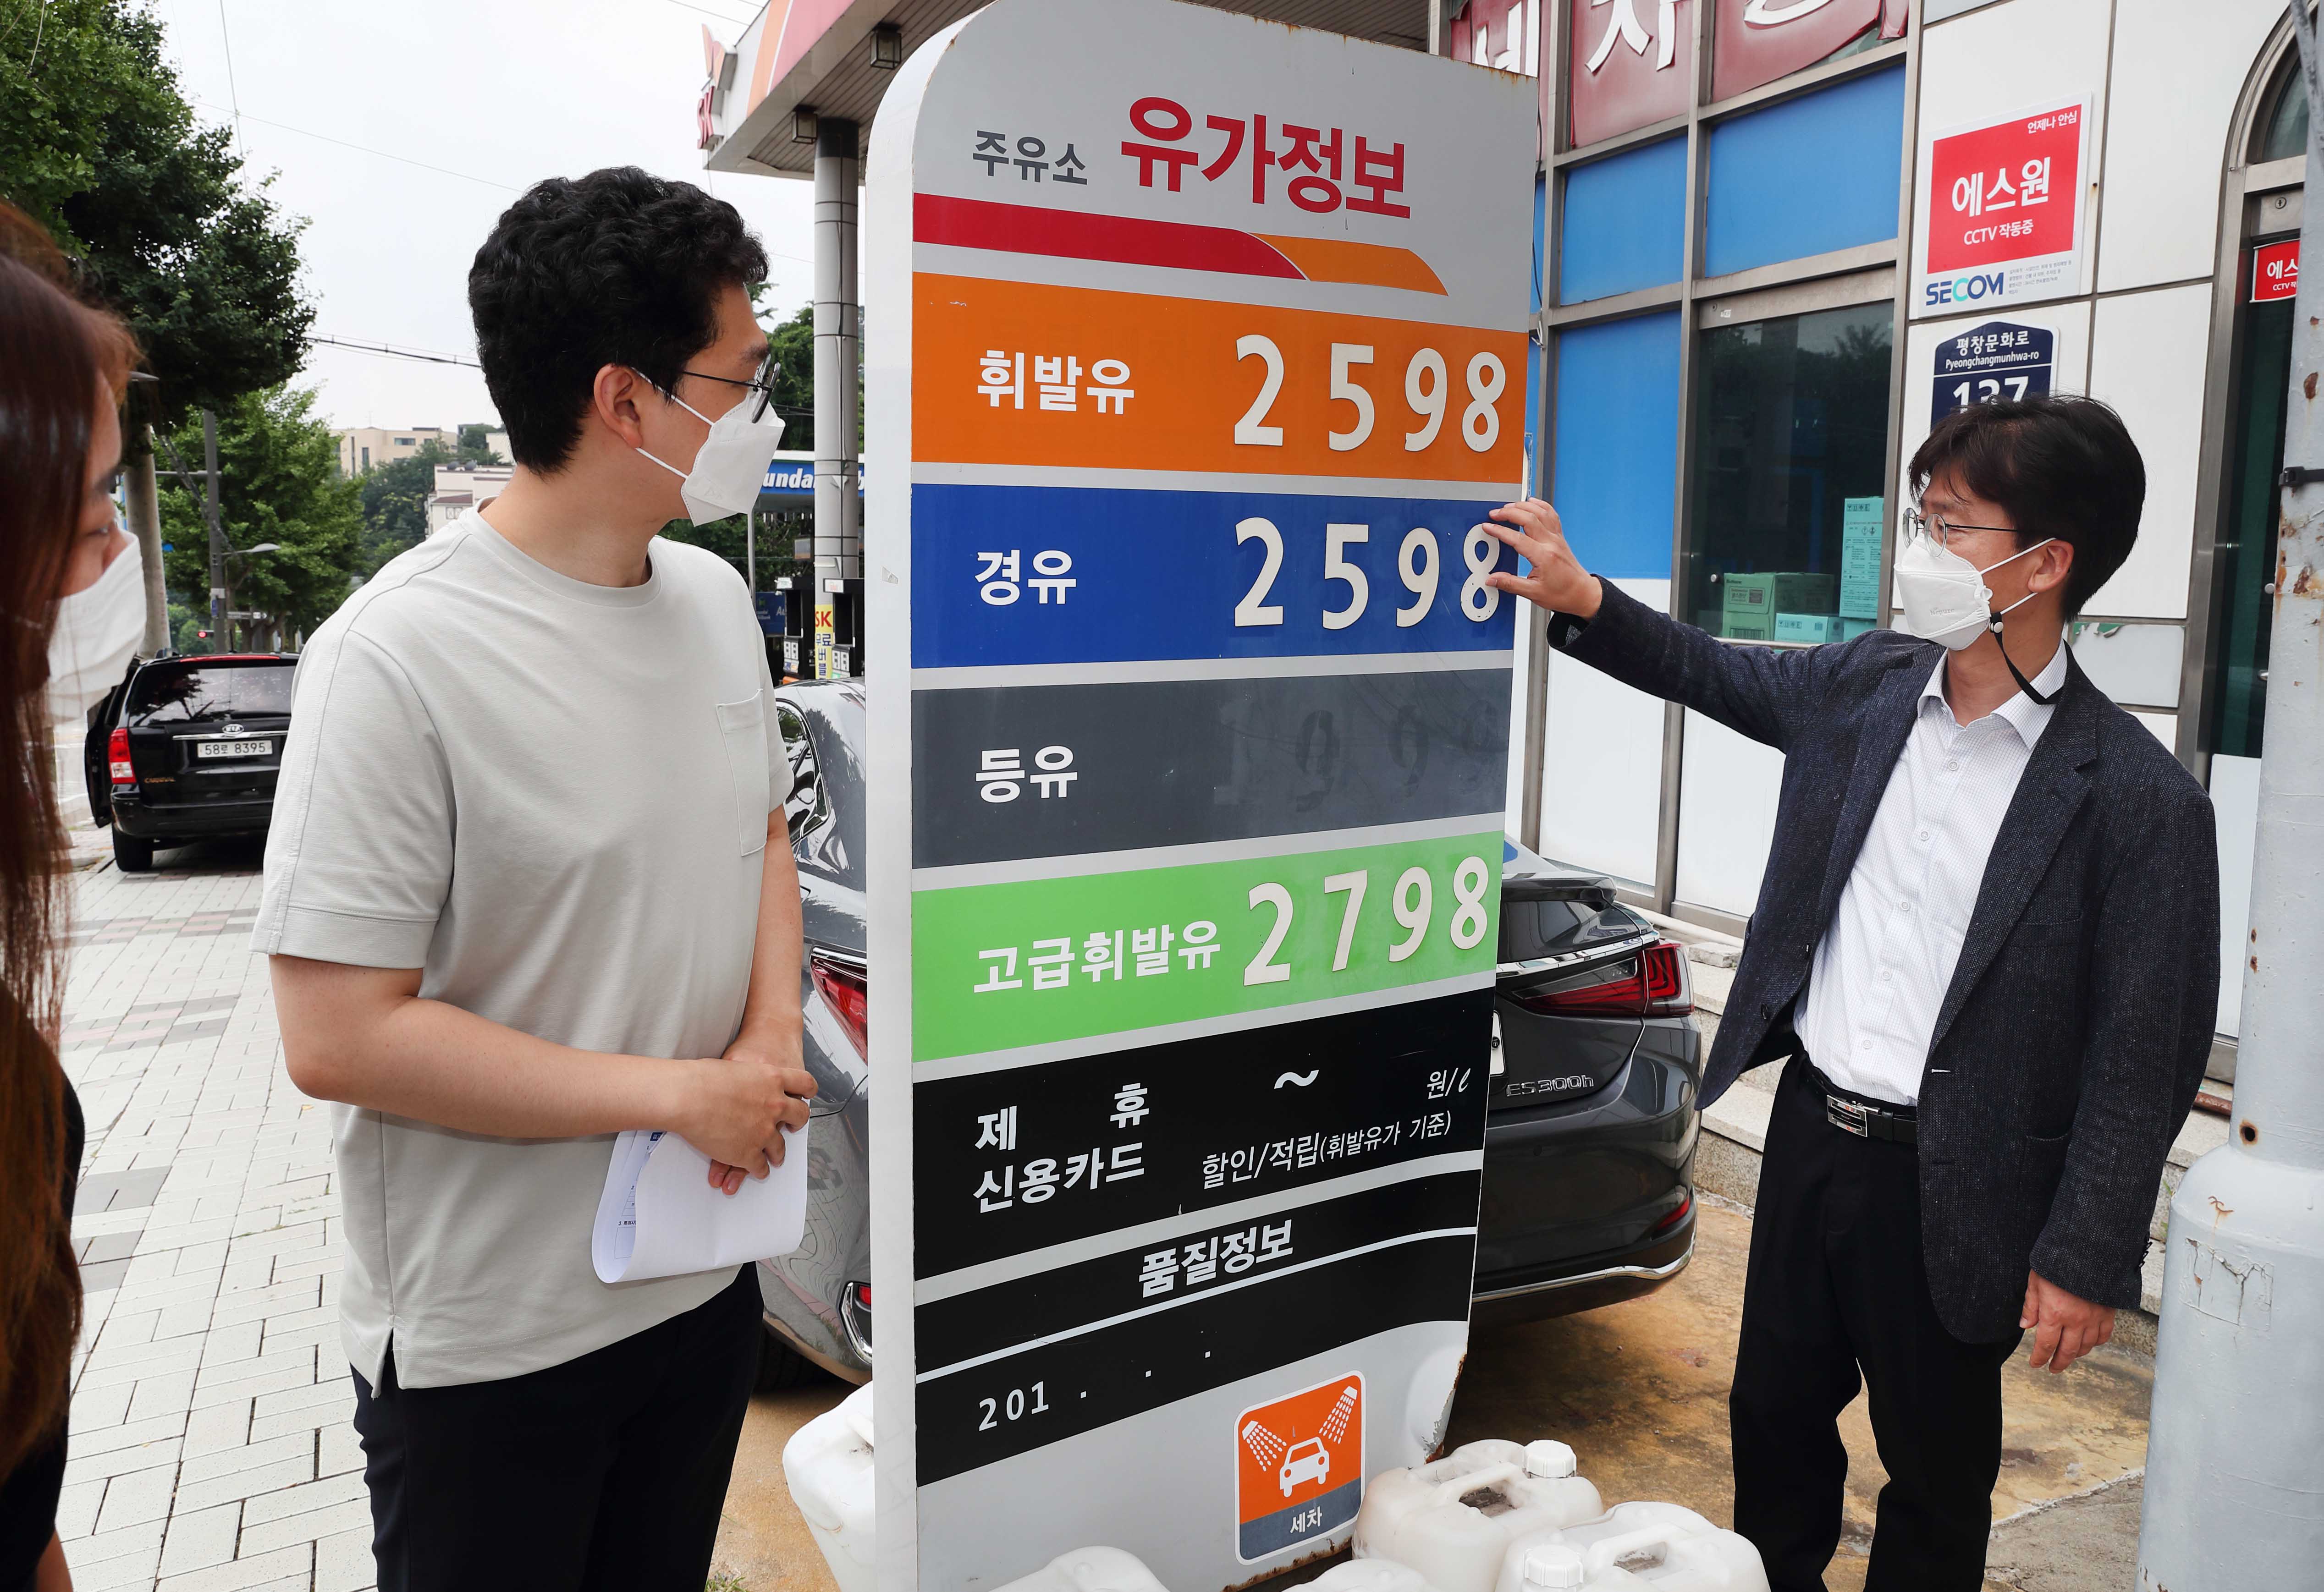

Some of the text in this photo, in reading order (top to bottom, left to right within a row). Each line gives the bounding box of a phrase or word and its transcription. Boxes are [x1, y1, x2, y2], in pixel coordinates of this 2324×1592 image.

[2027, 110, 2077, 134] 언제나 안심
[973, 97, 1410, 219] 주유소 유가정보
[1952, 157, 2051, 217] 에스원
[1964, 219, 2034, 245] CCTV 작동중
[1926, 272, 2004, 306] SECOM
[2267, 258, 2299, 279] 에스
[1946, 351, 2039, 371] Pyeongchangmunhwa-ro
[1956, 330, 2030, 357] 평창문화로
[977, 334, 1506, 453] 휘발유 2598
[975, 517, 1500, 631] 경유 2598
[234, 742, 266, 754] 8395
[975, 745, 1078, 803] 등유
[974, 856, 1489, 994] 고급휘발유 2798
[1410, 1110, 1452, 1141] 기준)
[973, 1142, 1145, 1214] 신용카드
[1140, 1219, 1294, 1298] 품질정보
[979, 1381, 1049, 1432] 201
[1290, 1506, 1322, 1534] 세차
